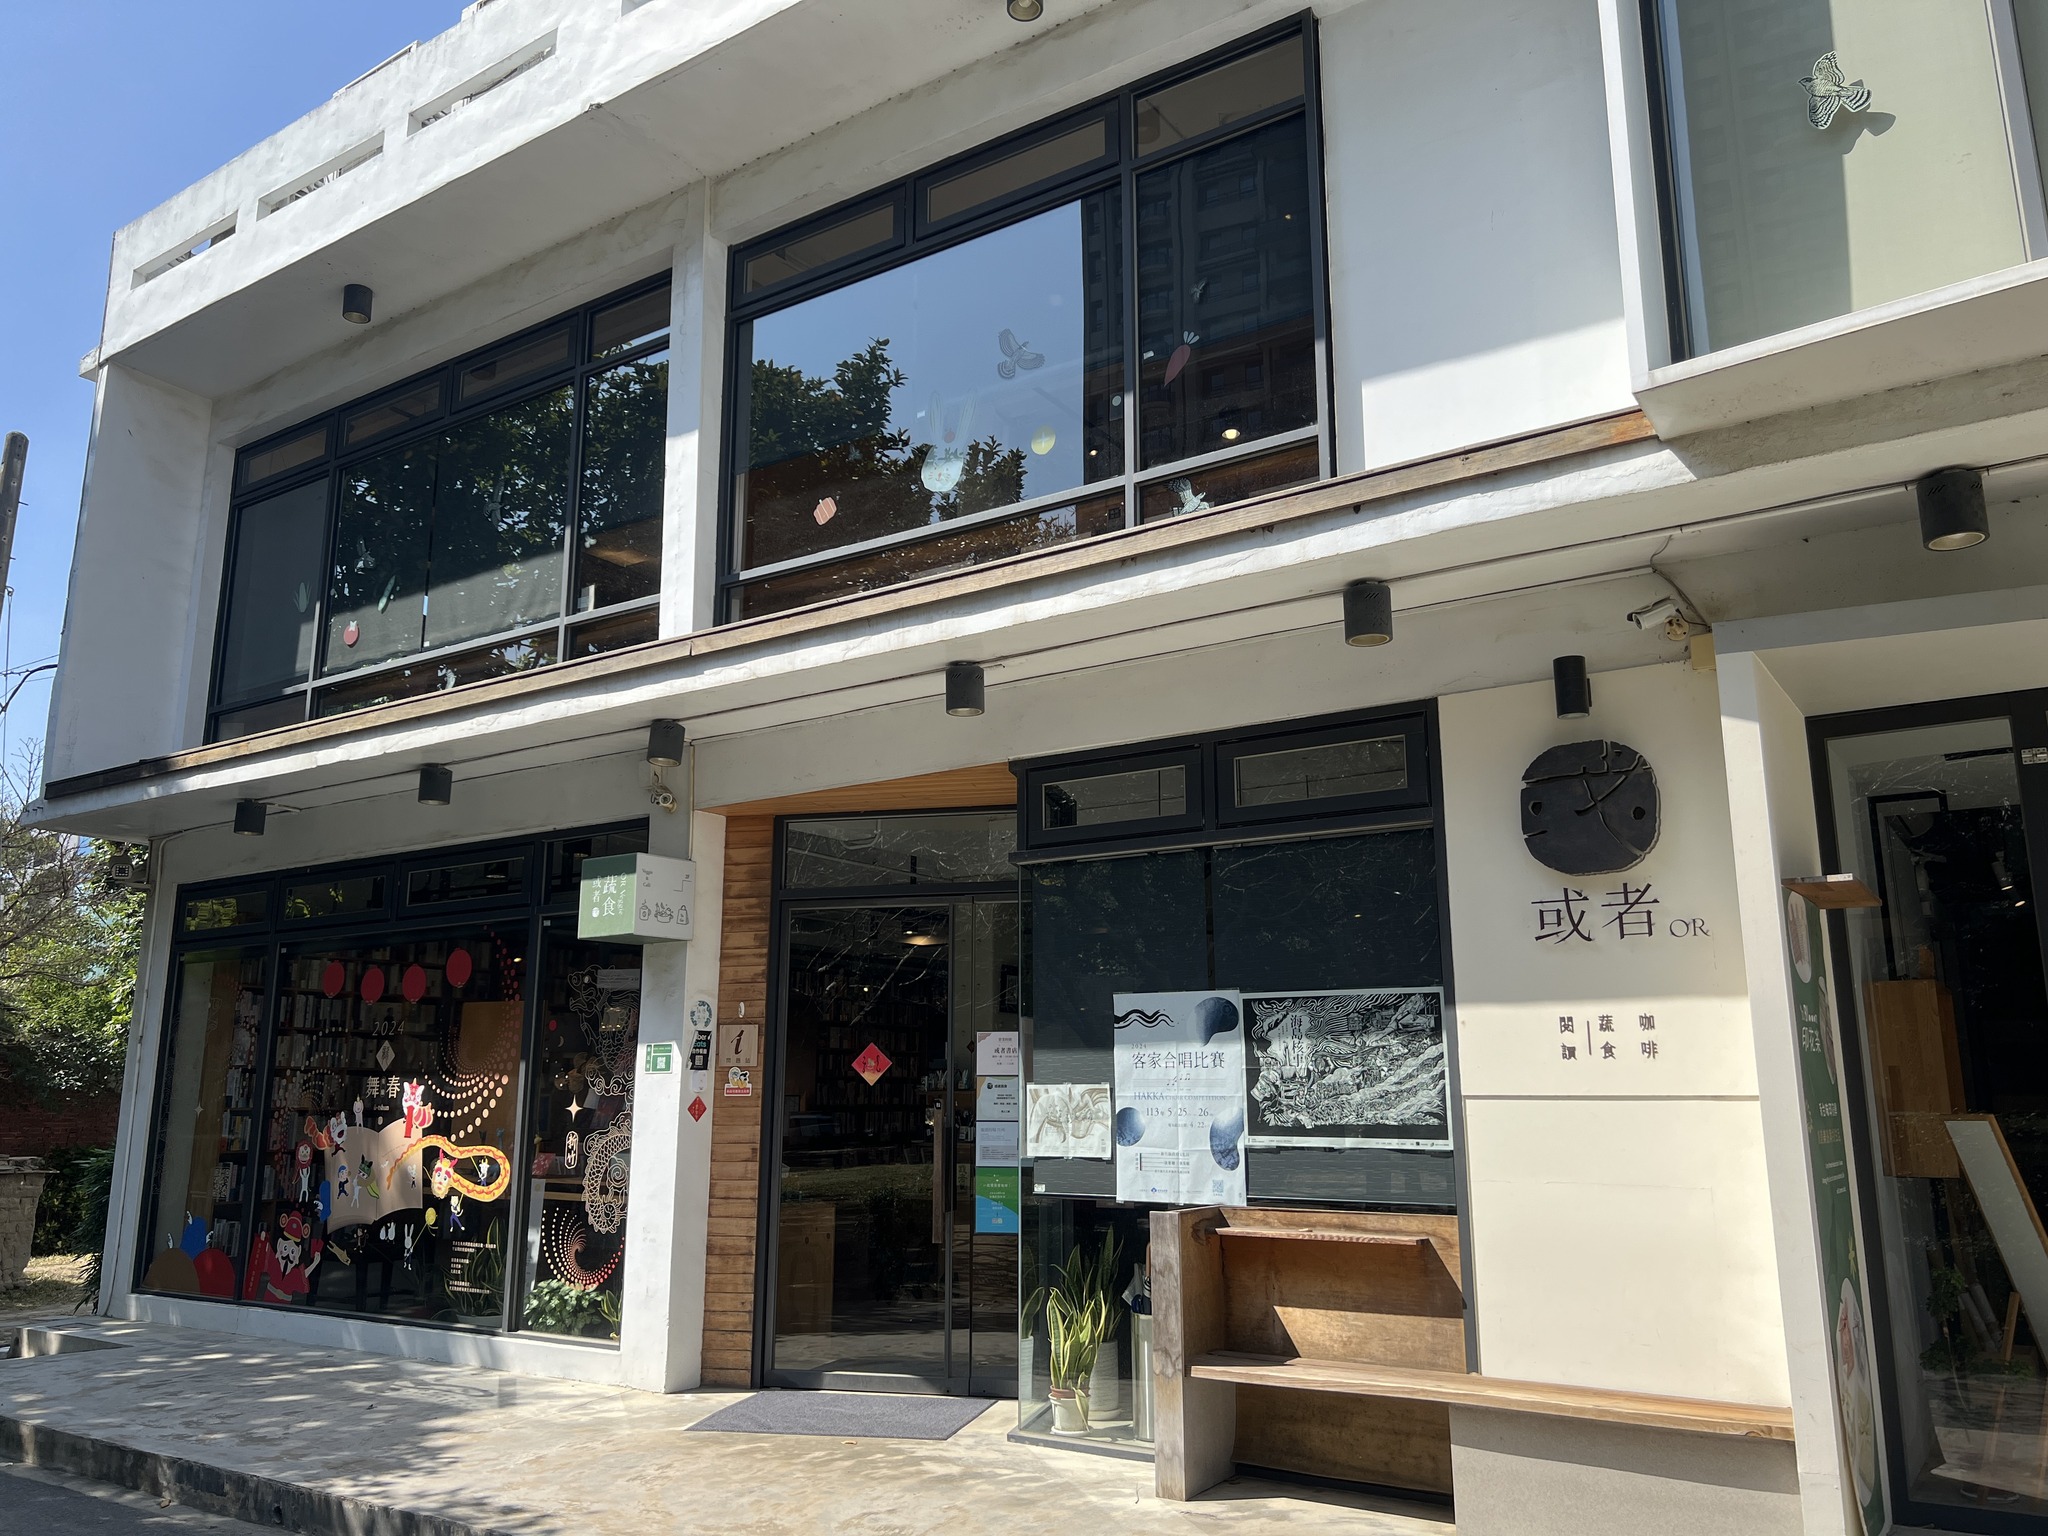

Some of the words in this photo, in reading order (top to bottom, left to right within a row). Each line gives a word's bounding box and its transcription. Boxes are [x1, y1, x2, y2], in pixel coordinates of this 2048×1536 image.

[592, 875, 602, 903] 或者
[602, 875, 618, 917] 蔬食
[1531, 882, 1660, 945] 或者
[1669, 917, 1711, 938] OR
[371, 1020, 405, 1036] 2024
[1598, 1014, 1617, 1061] 蔬食
[1638, 1012, 1659, 1060] 咖啡
[1132, 1051, 1225, 1069] 客家合唱比賽
[1134, 1092, 1164, 1100] HAKKA
